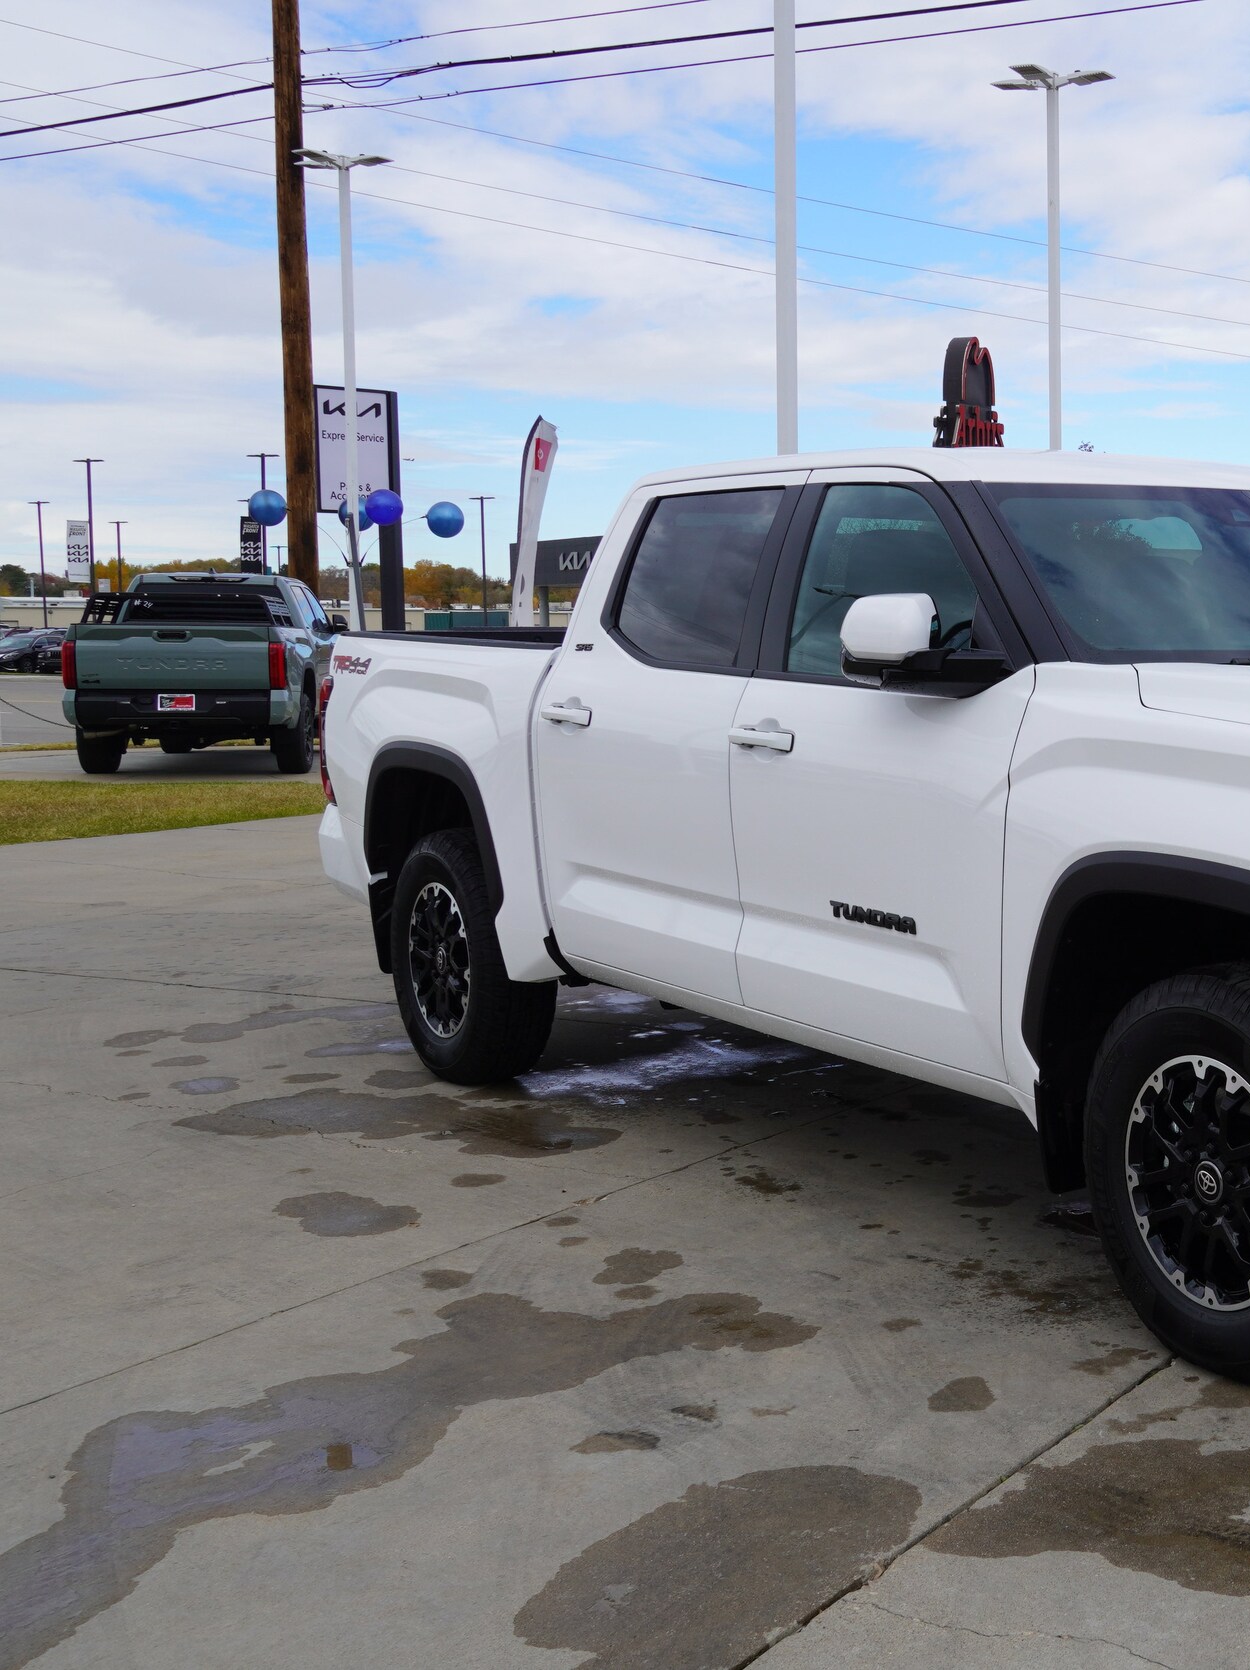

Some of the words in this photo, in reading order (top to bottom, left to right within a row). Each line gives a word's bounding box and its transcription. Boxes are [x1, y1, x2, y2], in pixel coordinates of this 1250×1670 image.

[356, 433, 385, 443] Service
[559, 551, 591, 570] KIA
[117, 658, 228, 670] TUNDRA
[829, 900, 917, 935] TUNDRA
